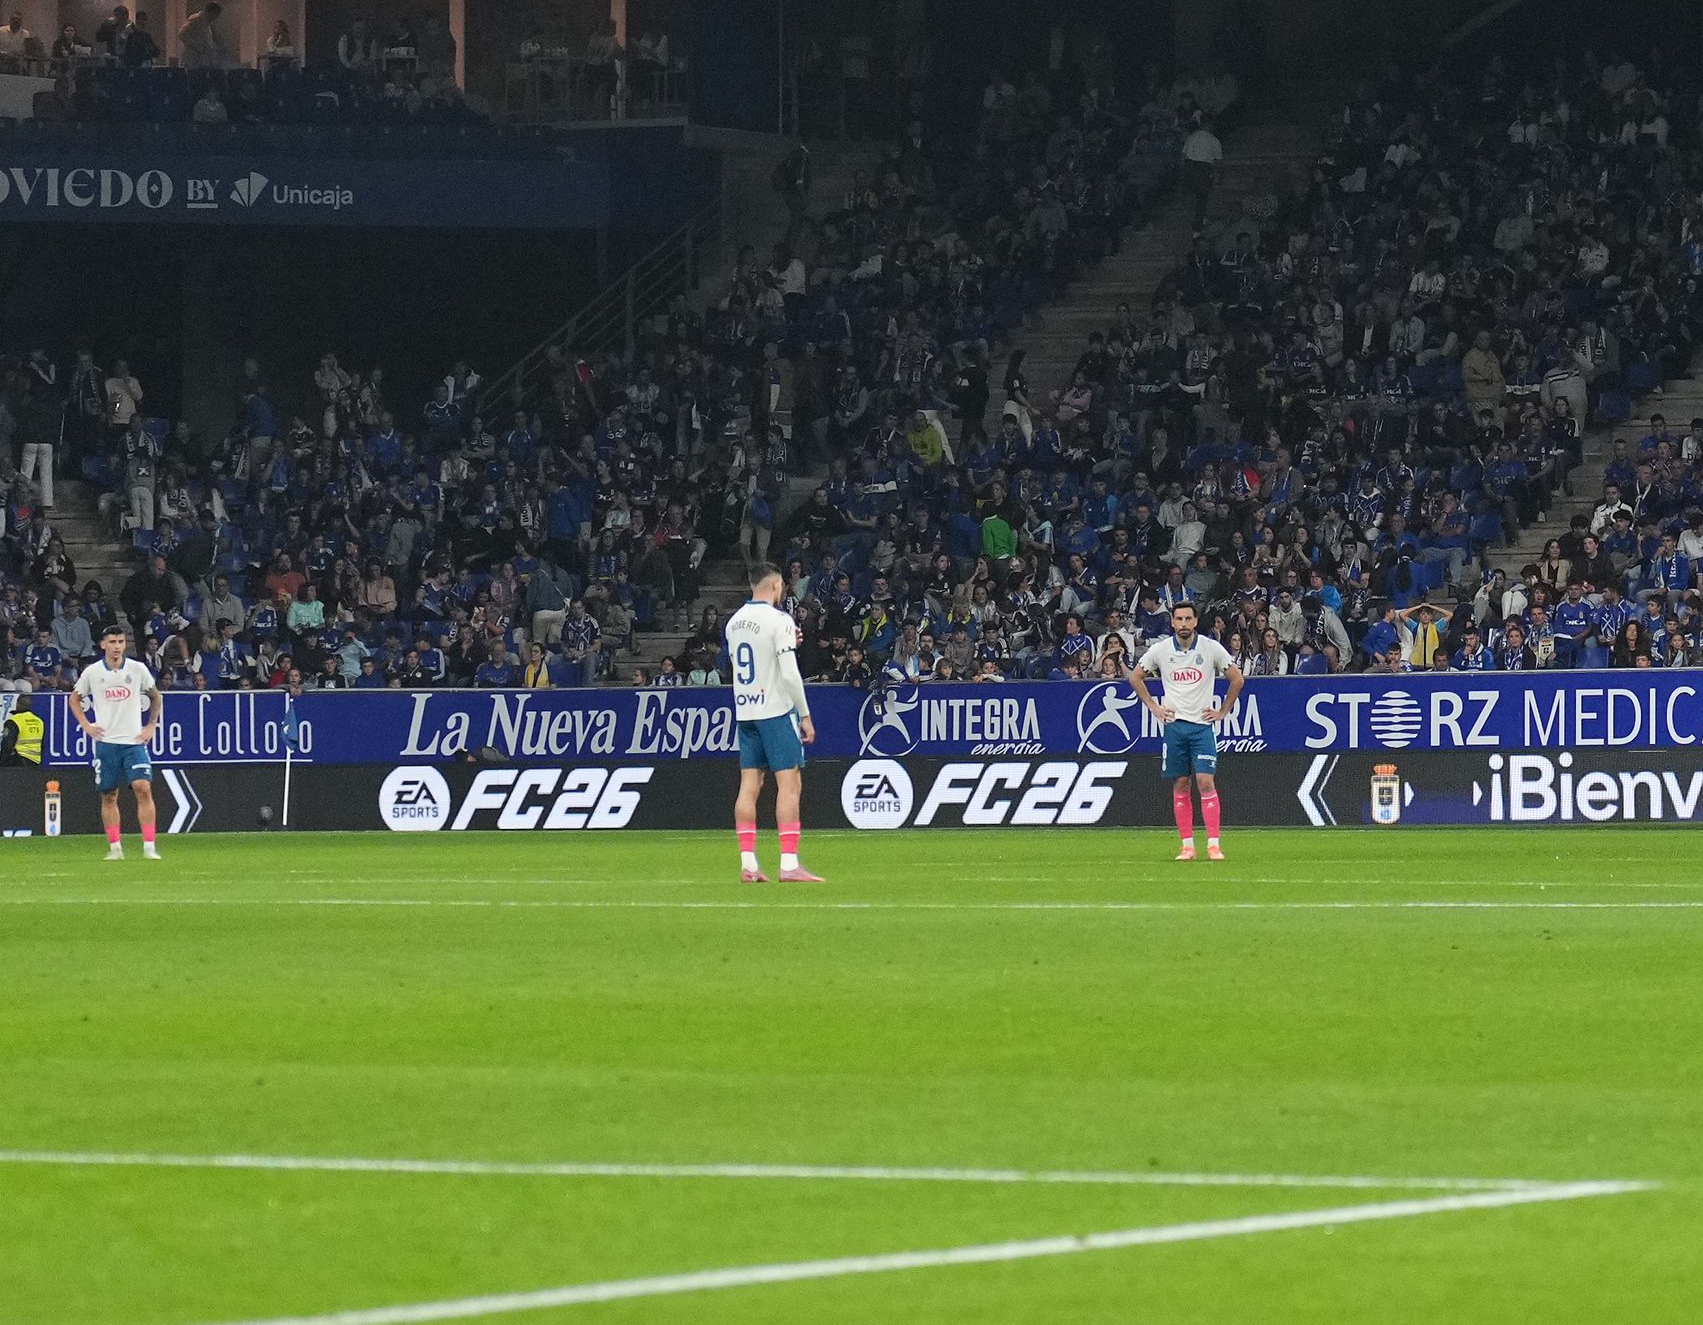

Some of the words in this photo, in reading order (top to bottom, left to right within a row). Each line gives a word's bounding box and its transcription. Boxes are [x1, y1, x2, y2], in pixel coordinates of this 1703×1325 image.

[186, 176, 220, 203] BY
[271, 181, 355, 212] Unicaja
[737, 642, 755, 685] 9
[1172, 669, 1201, 682] DANI
[105, 688, 127, 699] DANI
[736, 688, 765, 706] owi
[400, 692, 469, 757] La
[489, 693, 617, 757] Nueva
[625, 690, 737, 760] Espa
[921, 697, 1042, 742] INTEGRA
[1304, 689, 1500, 749] STORZ
[970, 739, 1046, 756] energía
[393, 779, 438, 805] EA
[451, 766, 656, 830] FC26
[855, 773, 895, 799] EA
[914, 761, 1129, 826] FC26
[392, 805, 439, 819] SPORTS
[853, 799, 901, 814] SPORTS
